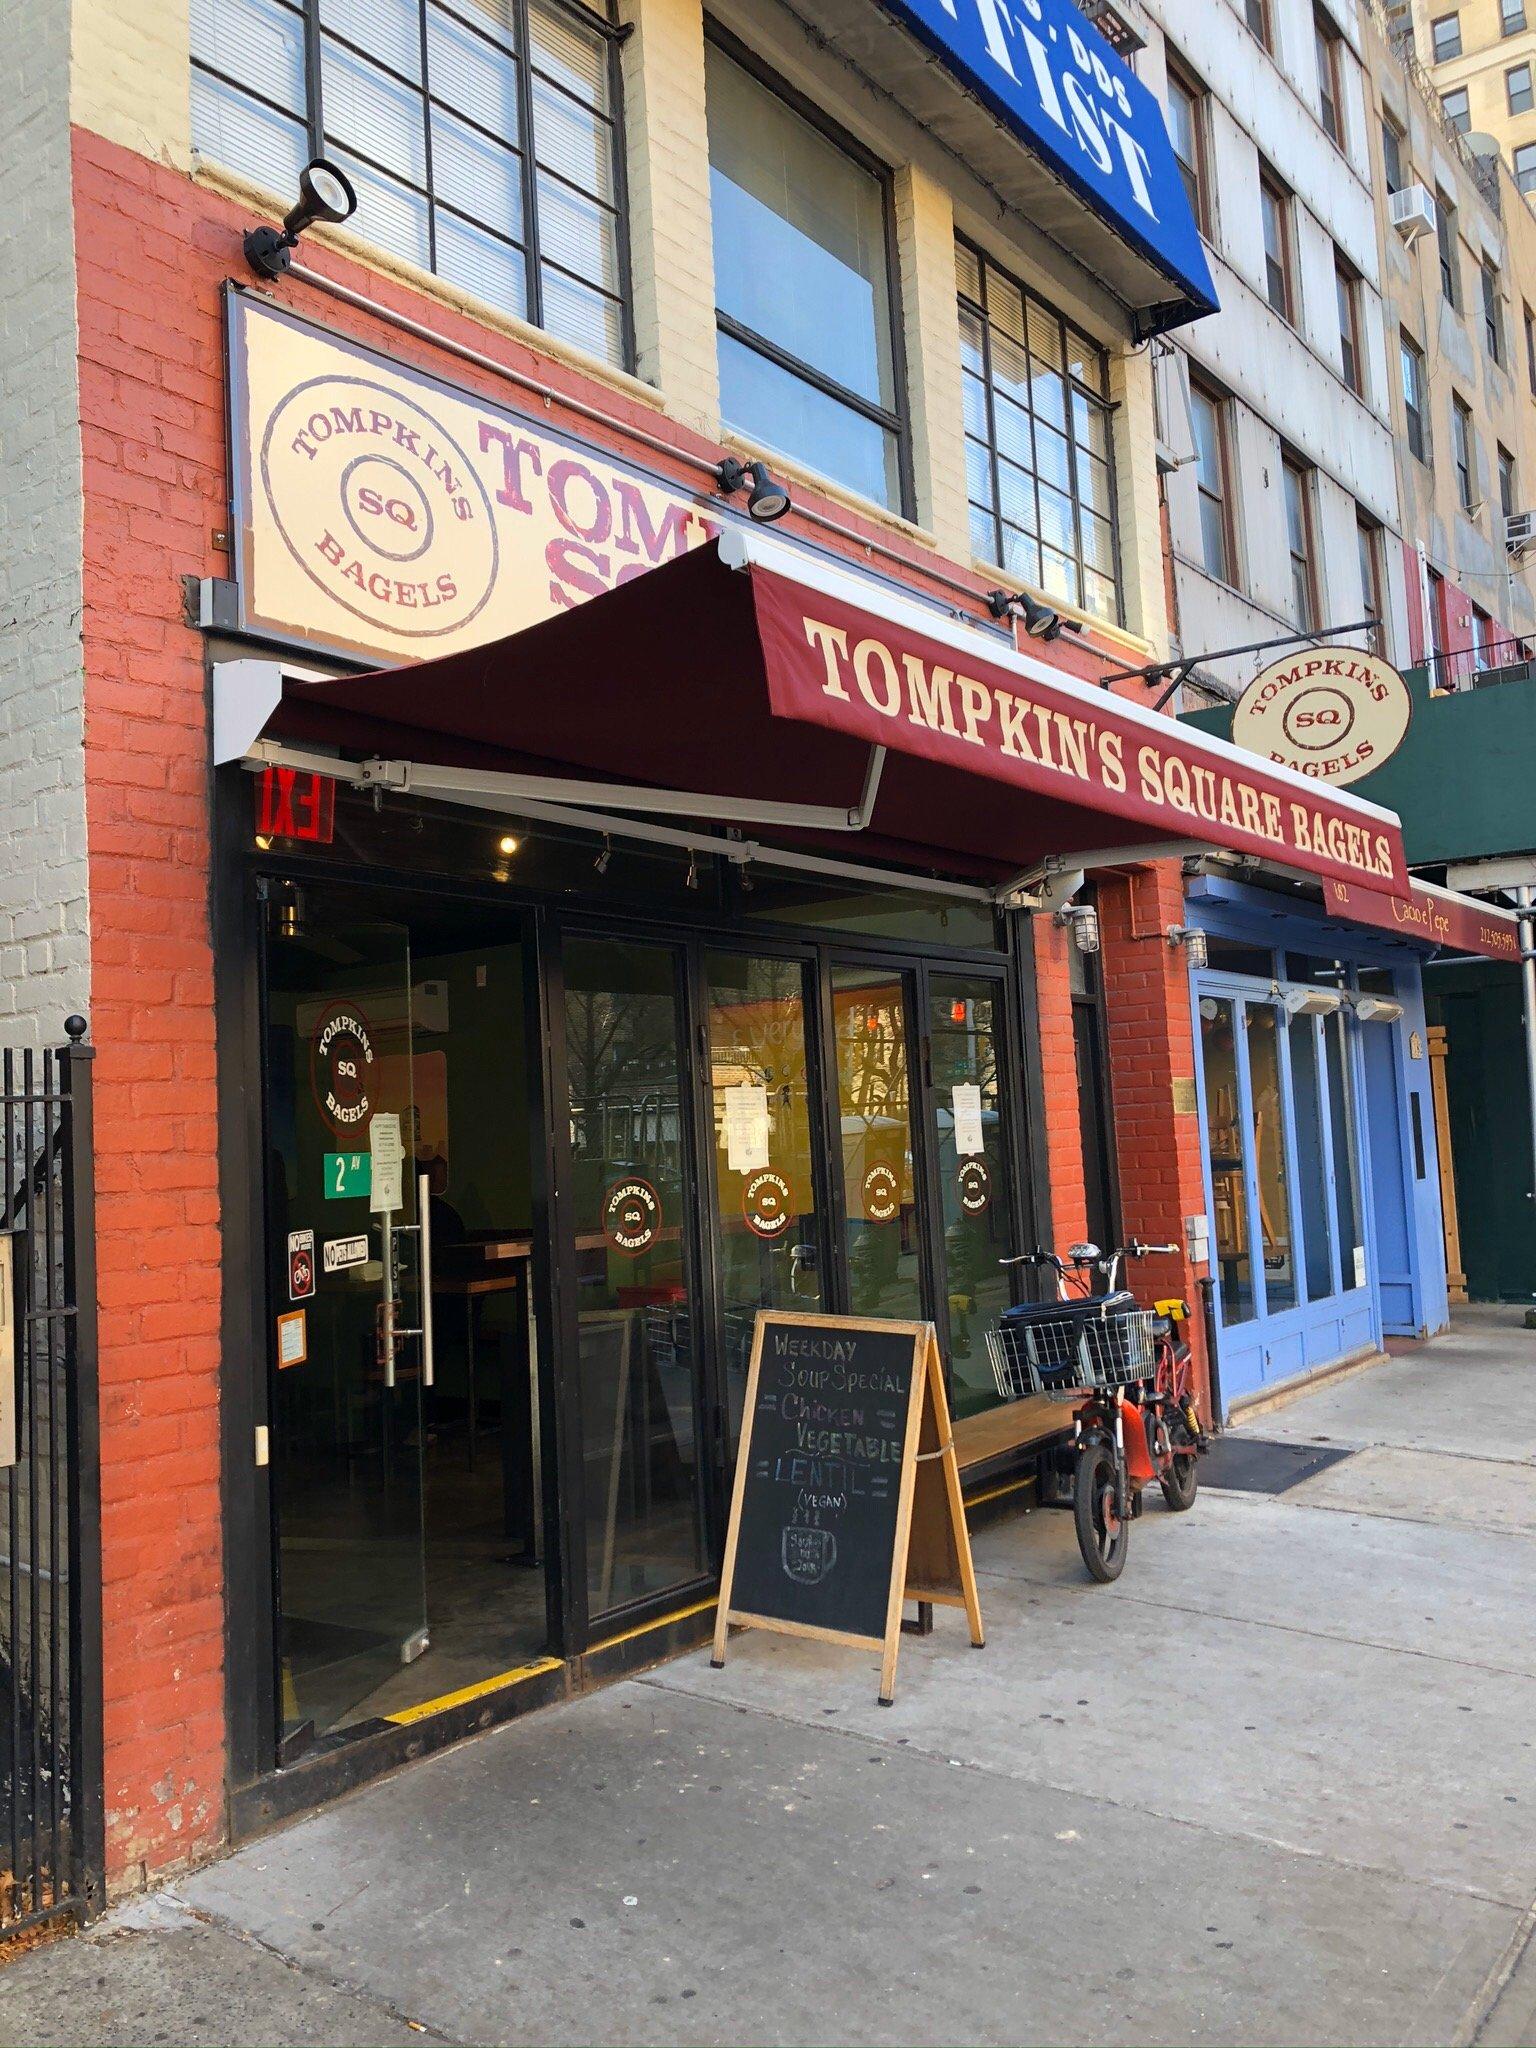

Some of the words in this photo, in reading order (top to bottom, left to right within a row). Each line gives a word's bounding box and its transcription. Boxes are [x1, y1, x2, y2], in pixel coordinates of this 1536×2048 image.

[1066, 24, 1132, 118] DDS
[940, 0, 1160, 224] TIST
[291, 407, 474, 521] TOMPKINS
[358, 487, 418, 532] SQ
[314, 528, 458, 608] BAGELS
[1250, 659, 1390, 716] TOMPKINS
[1296, 709, 1342, 729] SQ
[802, 616, 1127, 793] TOMPKIN'S
[1138, 746, 1285, 845] SQUARE
[1290, 802, 1394, 879] BAGELS
[319, 1015, 374, 1064] TOMPKINS
[338, 1060, 357, 1078] SQ
[325, 1092, 369, 1123] BAGELS
[336, 1157, 345, 1192] 2
[747, 1173, 789, 1198] TOMPKINS
[608, 1185, 655, 1213] TOMPKINS
[624, 1211, 641, 1221] SQ
[761, 1197, 776, 1206] SQ
[615, 1228, 652, 1248] BAGELS
[774, 1333, 857, 1361] WEEKDAY
[797, 1422, 901, 1463] VEGETABLE
[775, 1458, 866, 1496] LENTIL
